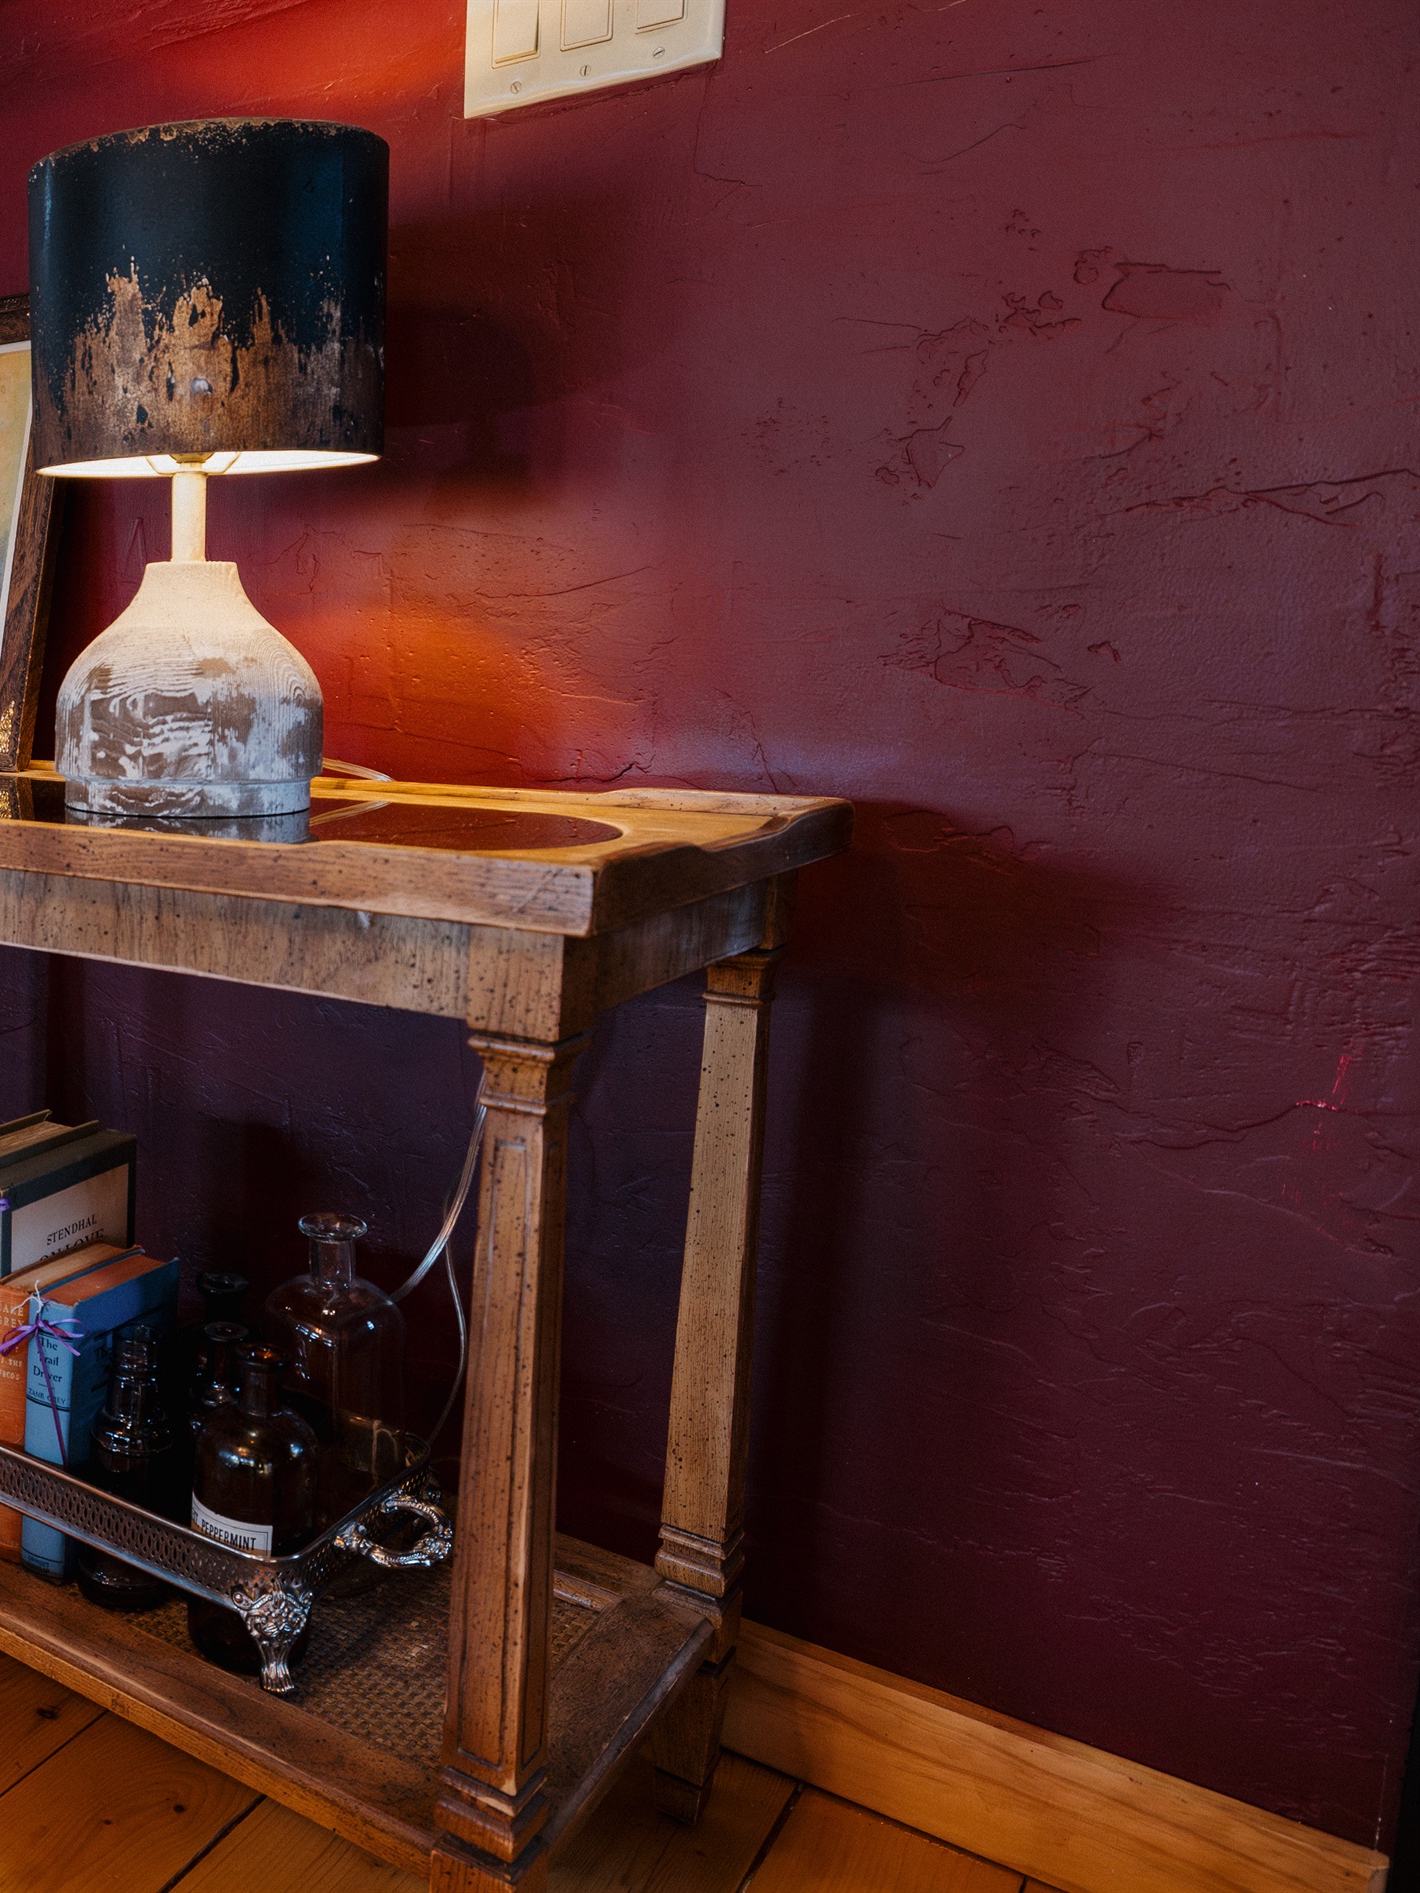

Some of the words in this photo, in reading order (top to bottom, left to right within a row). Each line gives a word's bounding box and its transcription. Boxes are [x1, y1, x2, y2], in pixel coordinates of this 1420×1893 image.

[46, 1214, 97, 1246] STENDHAL
[39, 1337, 59, 1351] The
[37, 1350, 59, 1367] rail
[33, 1365, 63, 1383] Drver
[201, 1518, 257, 1551] PEPPERMINT
